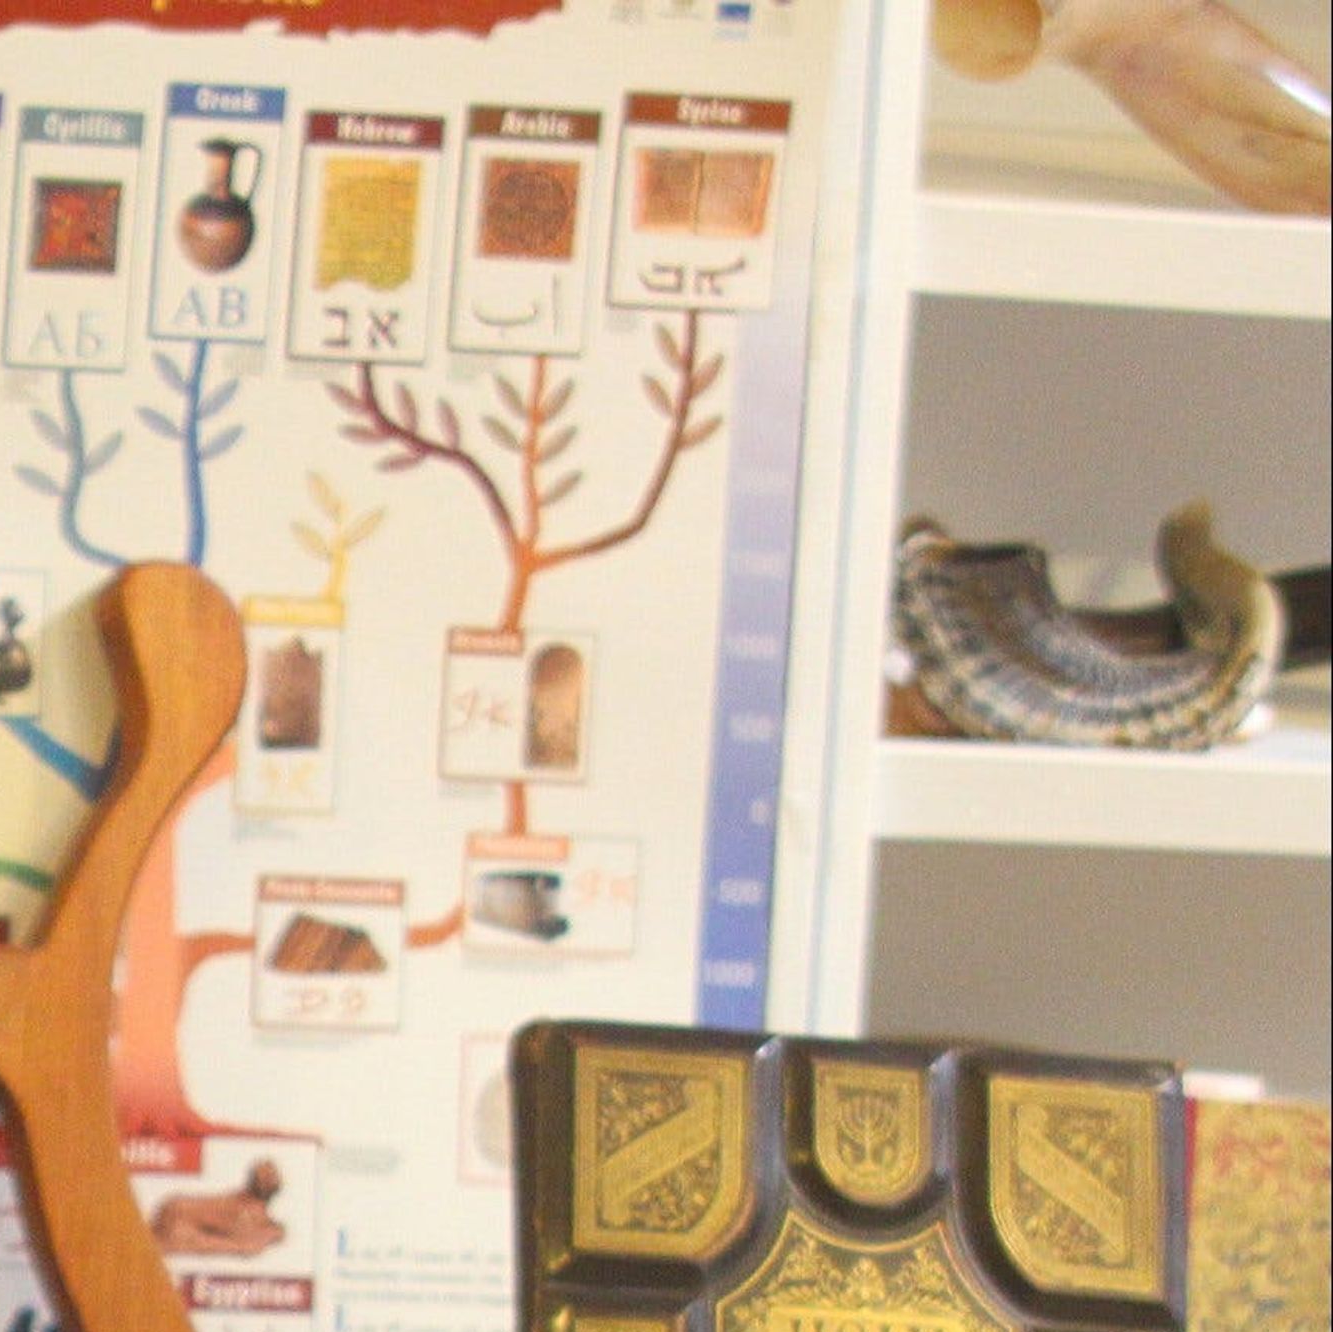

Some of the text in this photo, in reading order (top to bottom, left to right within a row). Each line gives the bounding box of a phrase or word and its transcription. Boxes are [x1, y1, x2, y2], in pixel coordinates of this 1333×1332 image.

[194, 88, 260, 114] Greek
[676, 96, 744, 124] Syriac
[42, 114, 127, 140] Cyrillic
[336, 116, 416, 144] Hebrew
[499, 109, 572, 139] Arabic
[192, 1274, 309, 1308] Egyptian
